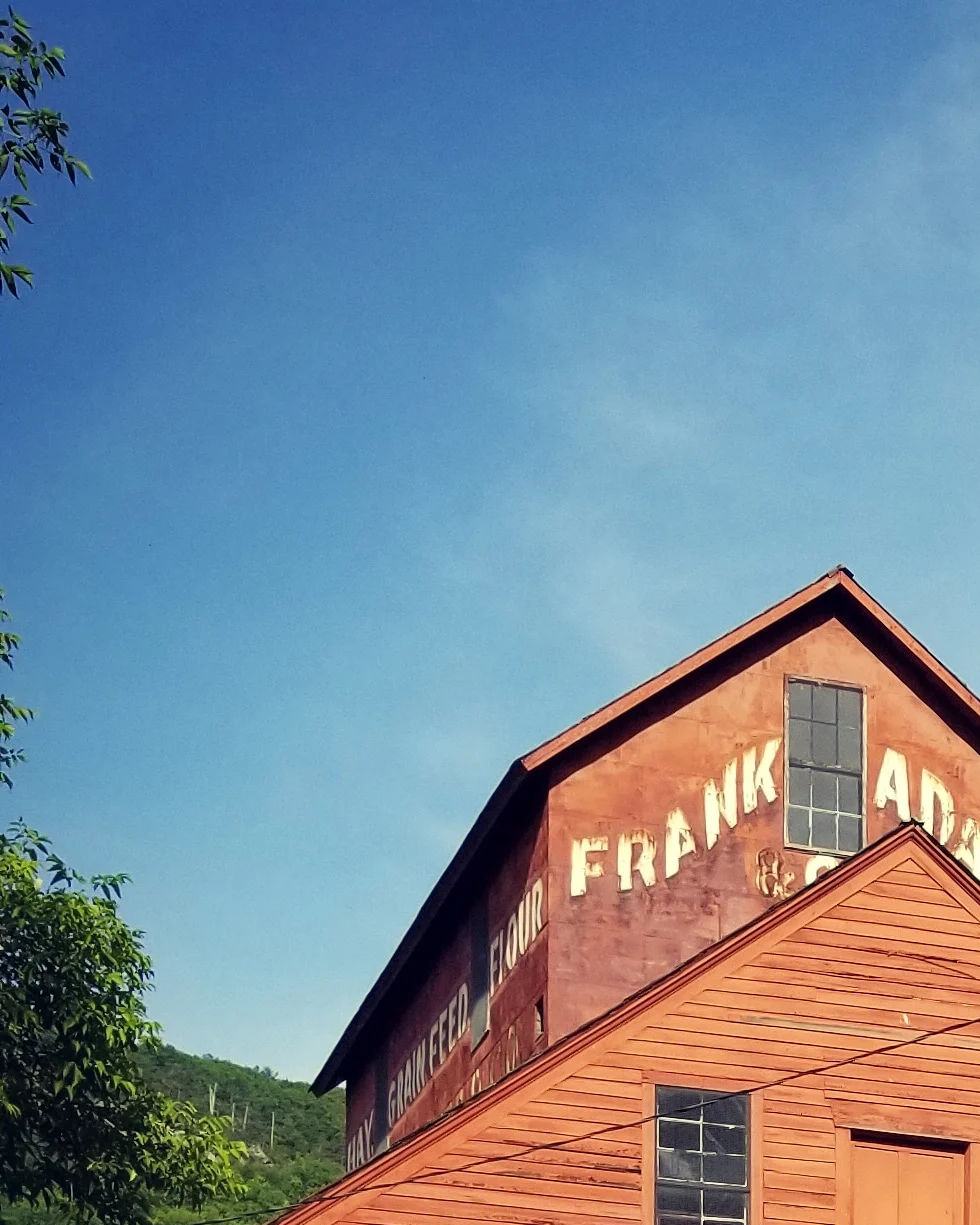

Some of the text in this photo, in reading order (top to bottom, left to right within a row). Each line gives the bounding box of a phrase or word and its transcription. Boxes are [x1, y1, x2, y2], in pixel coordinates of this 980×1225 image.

[570, 738, 782, 896] FRANK
[388, 1038, 425, 1128] GRAIN
[490, 878, 543, 997] FLOUR
